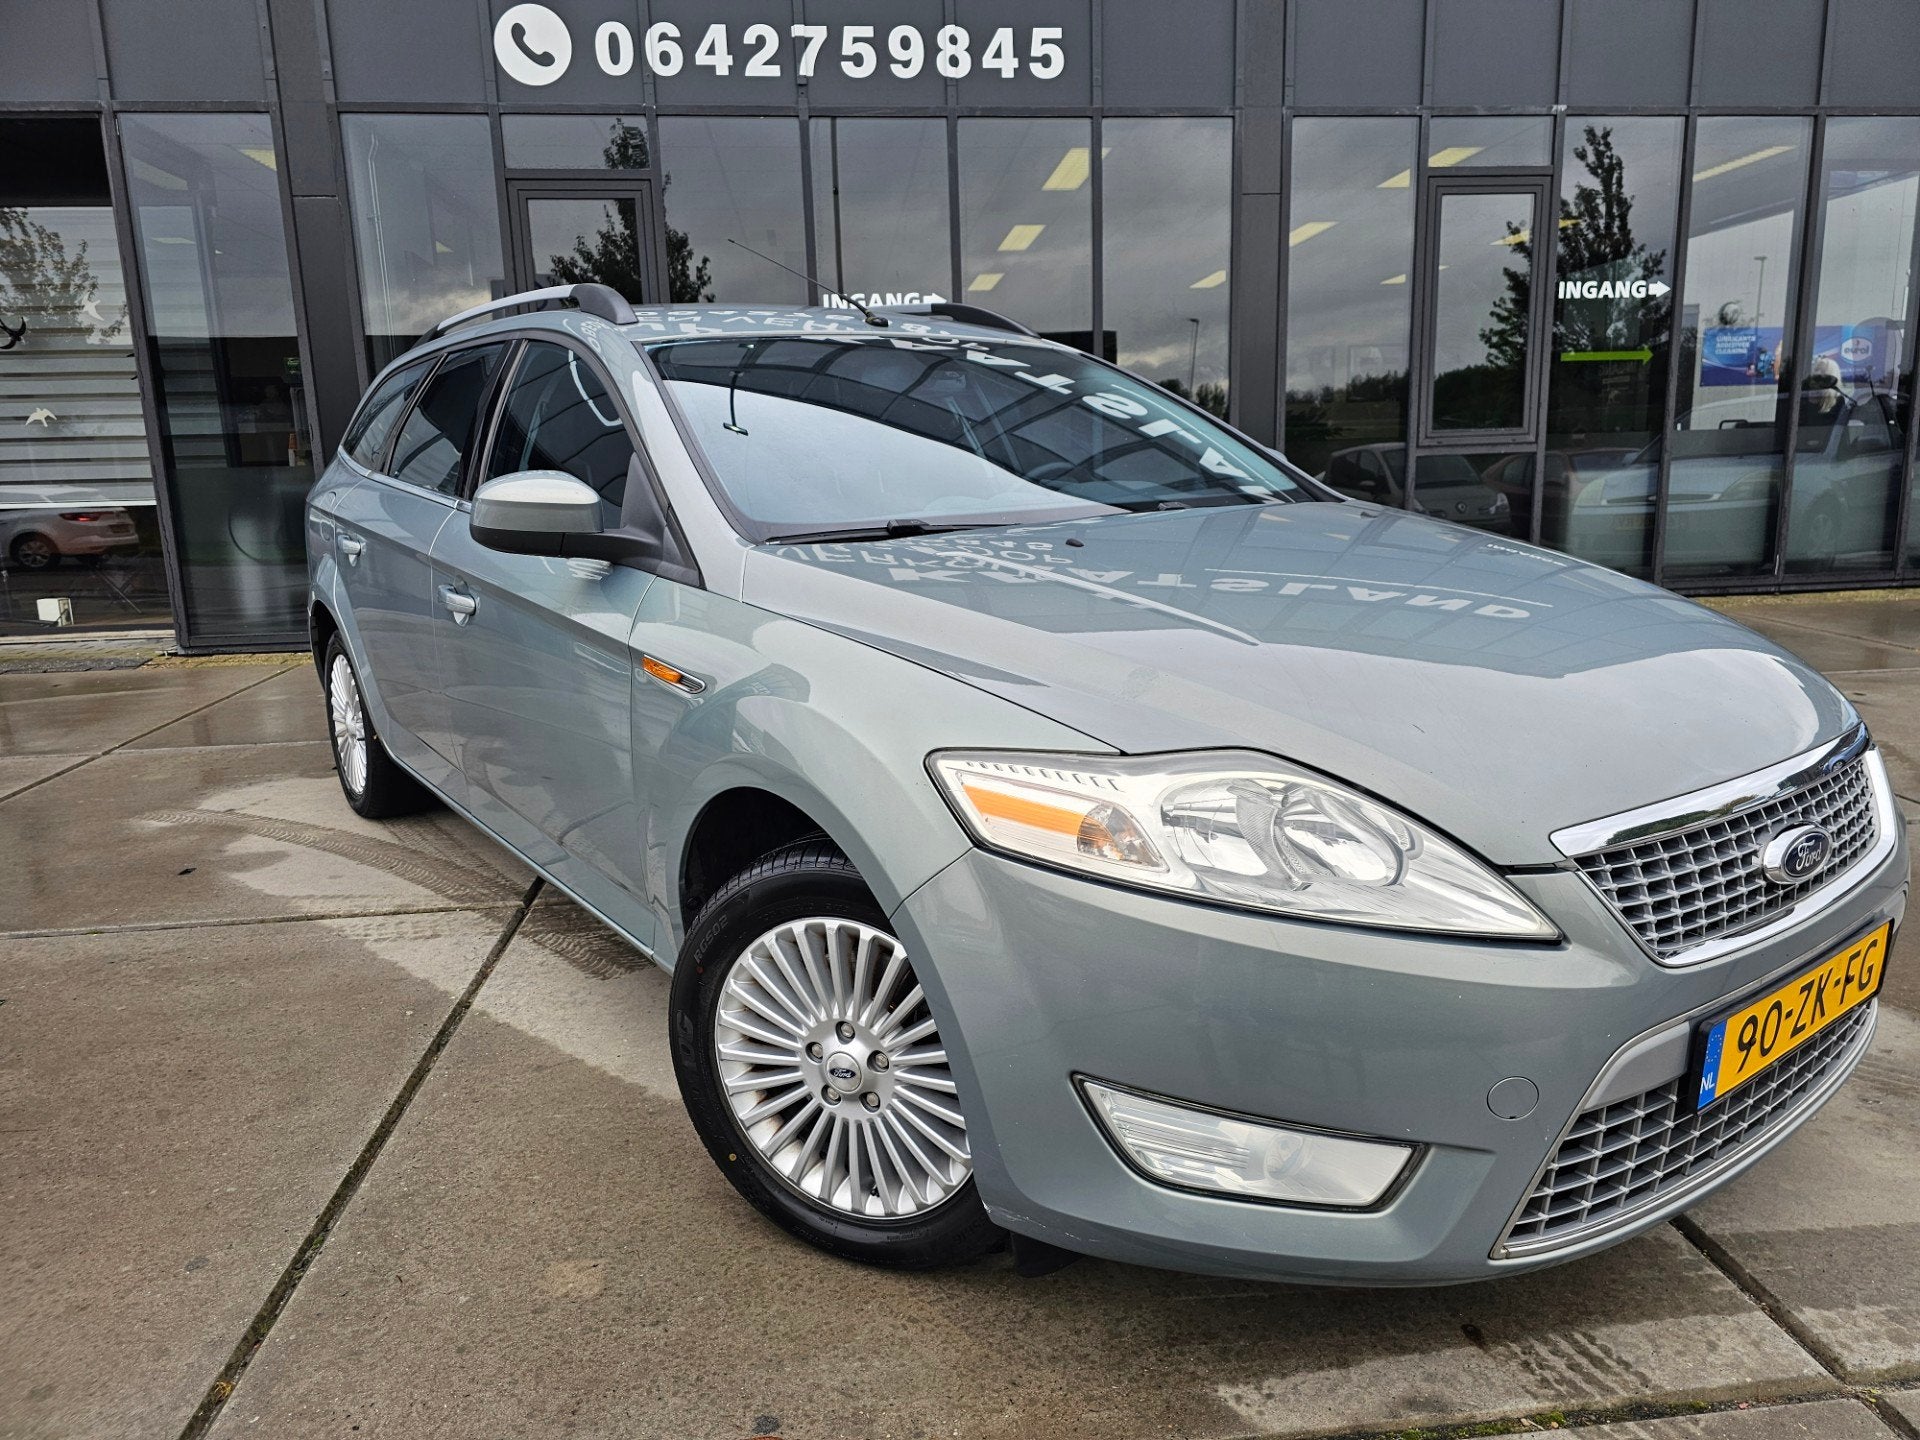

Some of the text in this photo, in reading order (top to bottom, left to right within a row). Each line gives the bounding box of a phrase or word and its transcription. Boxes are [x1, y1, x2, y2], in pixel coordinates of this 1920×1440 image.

[594, 21, 1065, 79] 0642759845
[822, 292, 921, 309] INGANG
[1558, 279, 1648, 300] INGANG
[1795, 839, 1823, 871] Ford
[1736, 938, 1879, 1074] 90-ZK-FG
[1700, 1074, 1716, 1094] NL
